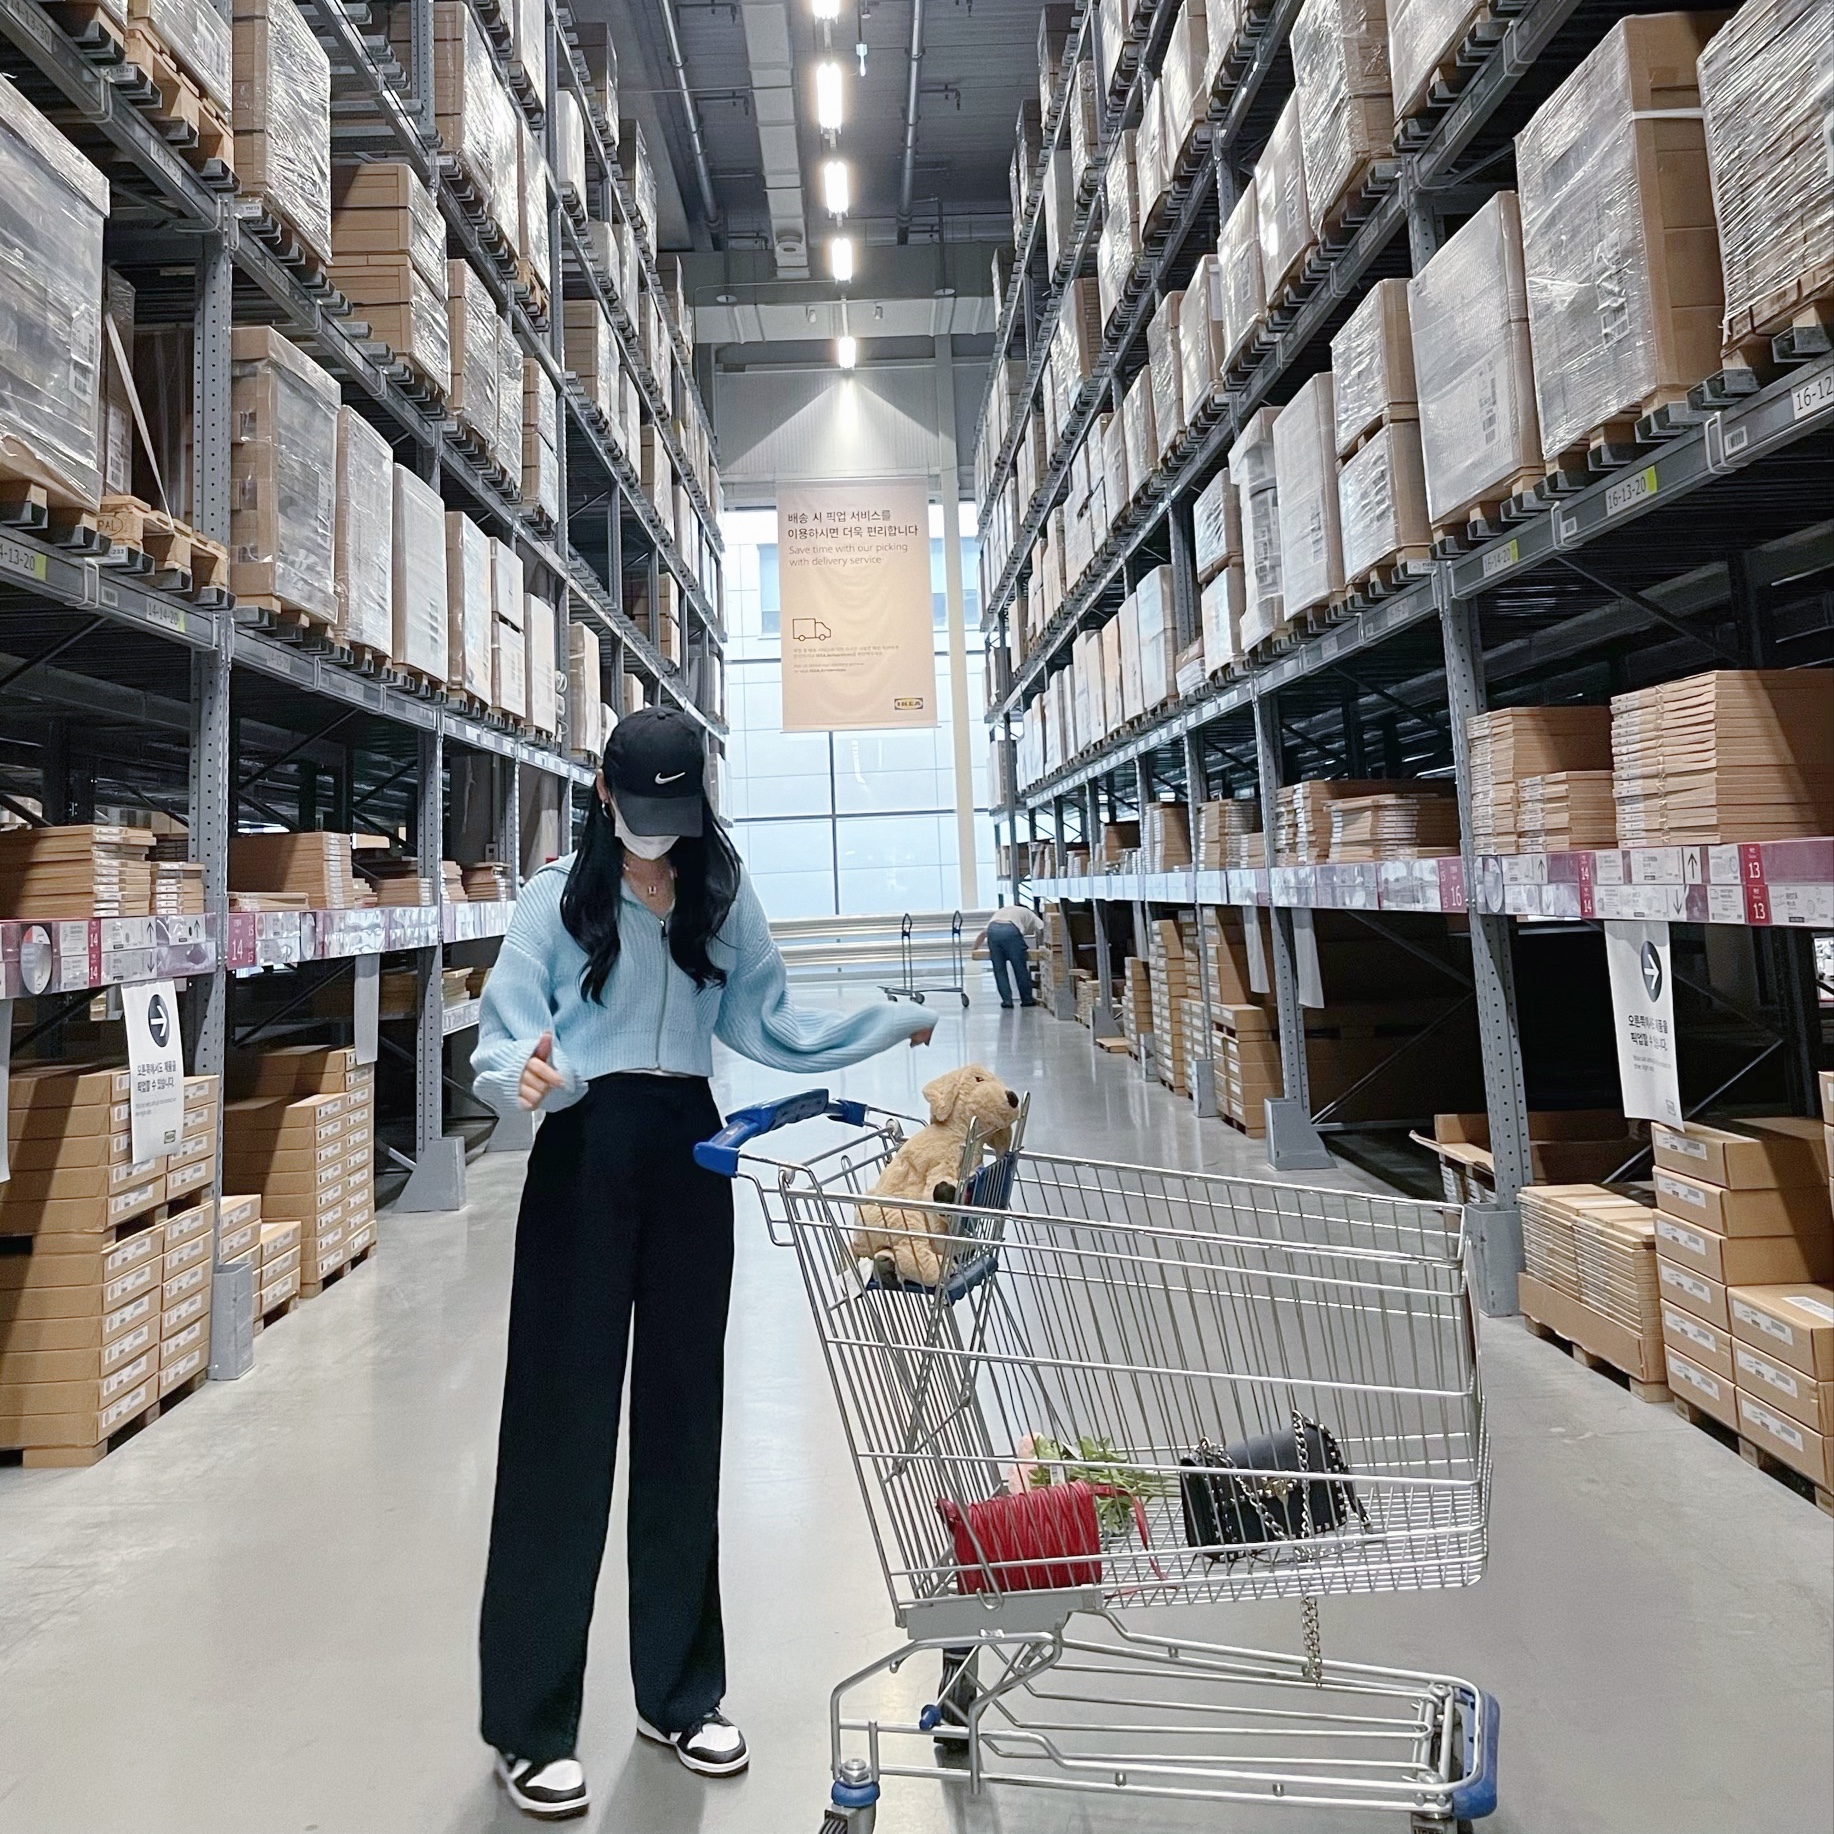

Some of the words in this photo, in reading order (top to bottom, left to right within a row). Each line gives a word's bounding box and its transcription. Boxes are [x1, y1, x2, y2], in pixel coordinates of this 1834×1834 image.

[1609, 476, 1646, 509] 16-13-20
[787, 512, 808, 524] 배송
[812, 511, 822, 523] 시
[826, 511, 846, 522] 픽업
[850, 509, 891, 522] 서비스를
[787, 527, 839, 540] 이용하시면
[842, 526, 863, 538] 더욱
[866, 525, 919, 537] 편리합니다
[789, 545, 811, 555] Save
[812, 545, 833, 554] time
[835, 544, 855, 553] with
[875, 543, 908, 554] picking
[790, 557, 809, 567] with
[811, 556, 848, 567] delivery
[850, 556, 882, 564] service
[1580, 866, 1590, 880] 14
[1748, 861, 1761, 879] 13
[1450, 884, 1463, 907] 16
[1583, 899, 1592, 913] 14
[1753, 902, 1766, 920] 13
[89, 932, 99, 948] 14
[232, 939, 244, 961] 14
[89, 965, 99, 980] 14
